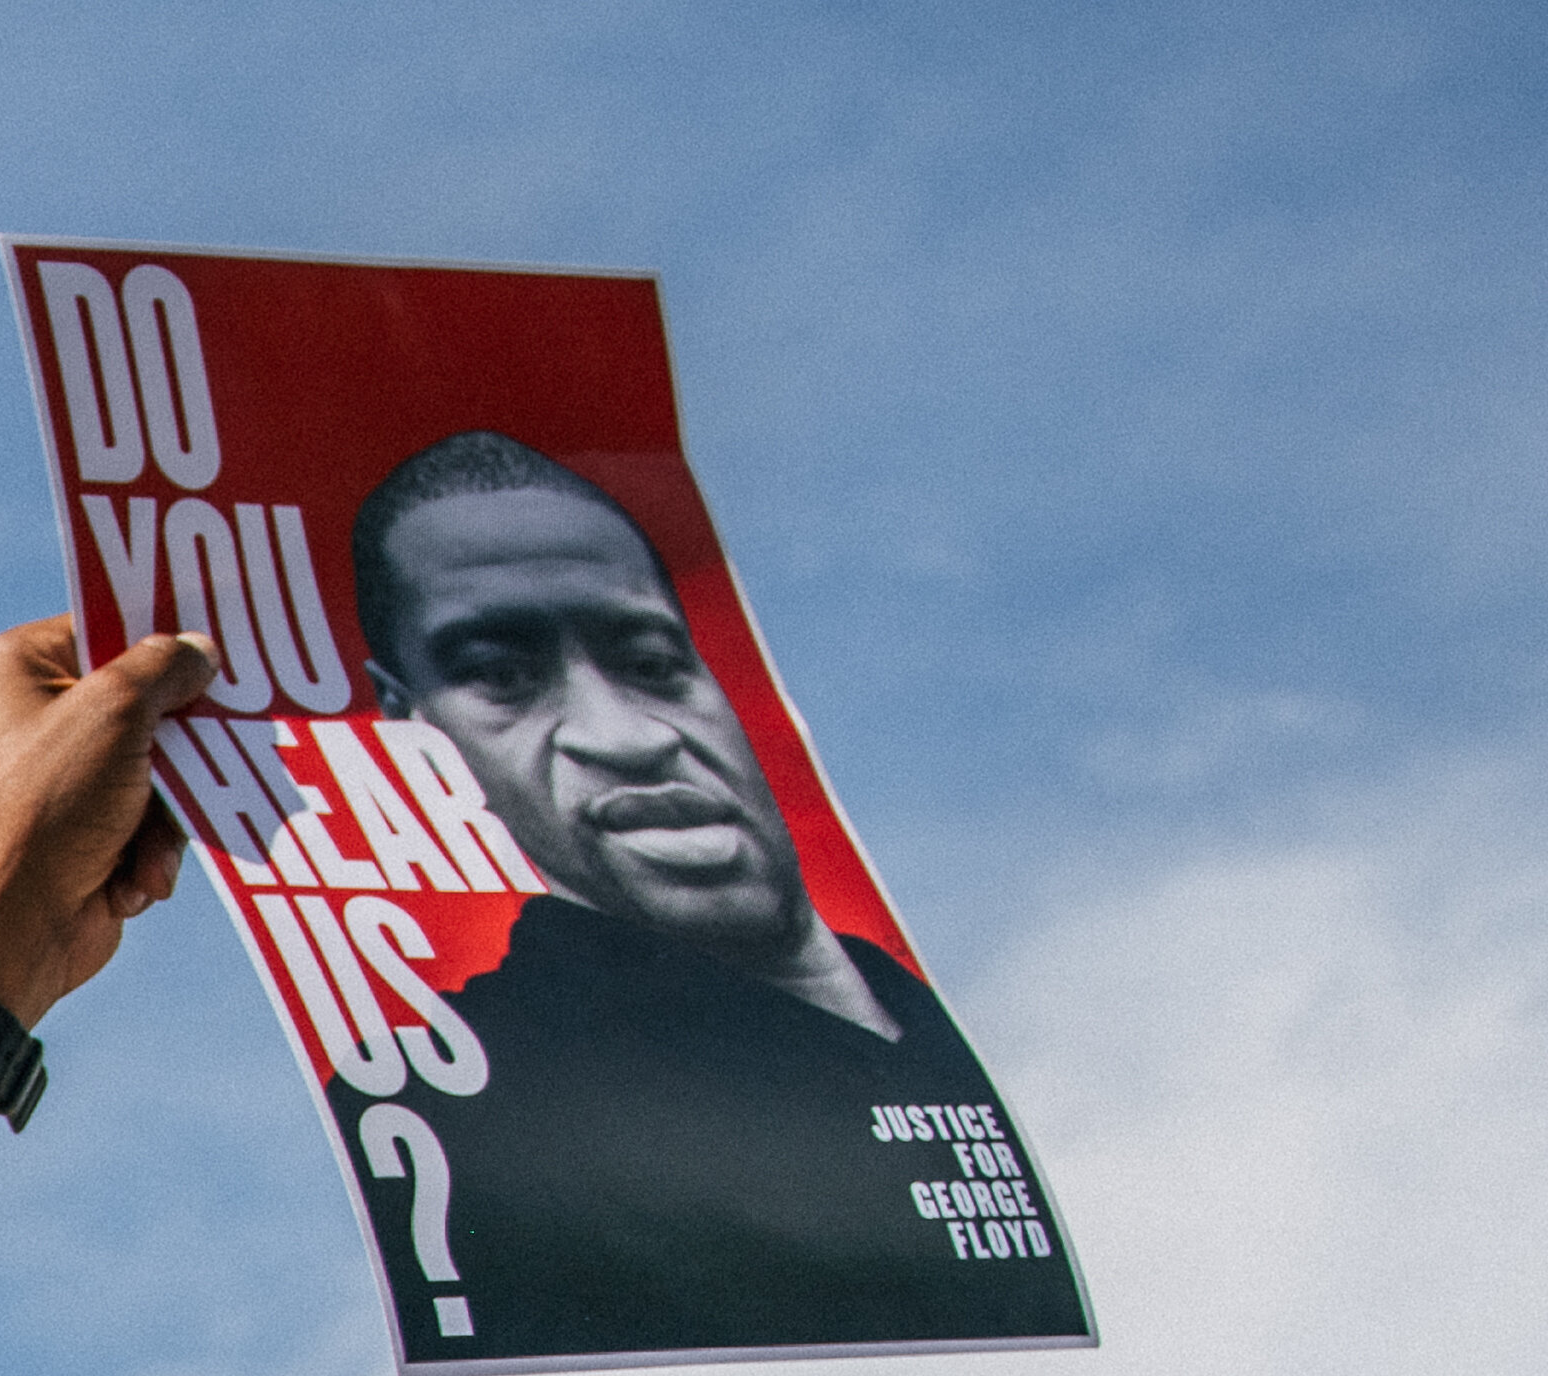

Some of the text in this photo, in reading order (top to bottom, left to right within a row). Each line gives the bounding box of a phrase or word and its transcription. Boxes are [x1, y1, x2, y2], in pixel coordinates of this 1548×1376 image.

[36, 259, 222, 490] DO
[79, 494, 352, 714] YOU
[155, 717, 550, 893] HEAR
[251, 894, 489, 1097] US
[870, 1103, 1005, 1142] JUSTICE
[908, 1179, 1038, 1220] GEORGE
[951, 1142, 1023, 1179] FOR
[358, 1102, 475, 1336] ?
[945, 1218, 1052, 1260] FLOYD
